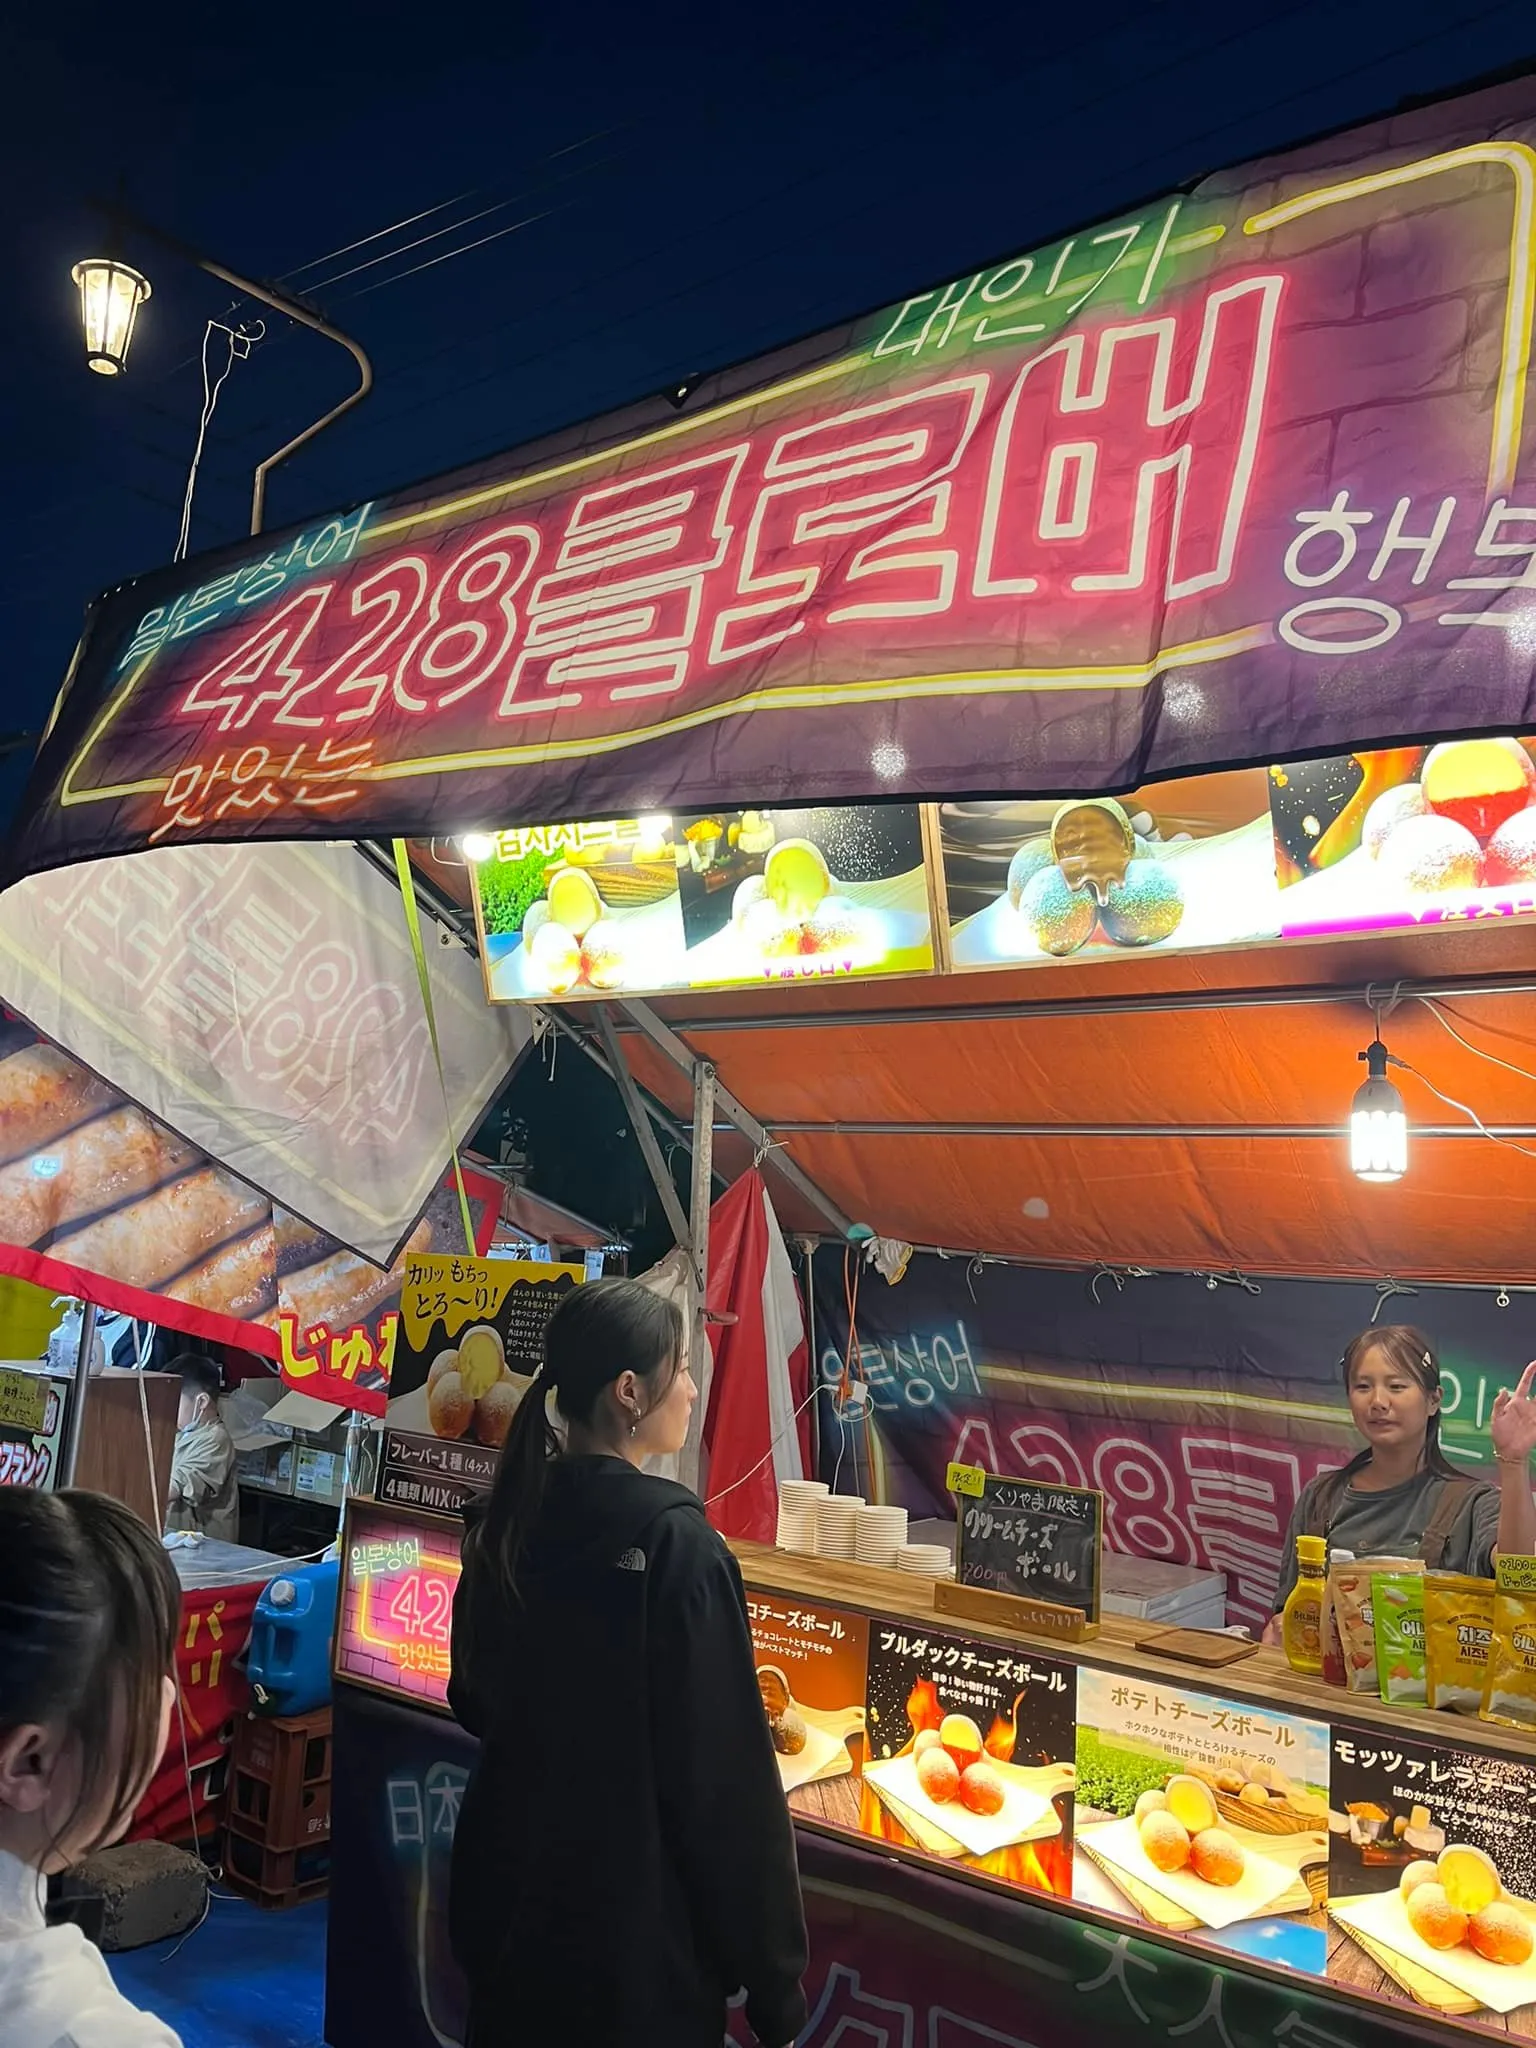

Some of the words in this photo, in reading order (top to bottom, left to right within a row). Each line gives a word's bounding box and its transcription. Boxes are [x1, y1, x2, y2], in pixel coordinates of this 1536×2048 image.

[873, 202, 1182, 357] 대인기
[118, 502, 375, 672] 일본상어
[149, 738, 376, 842] 맛있는
[408, 1264, 443, 1286] カリッ
[451, 1260, 489, 1284] もちっ
[350, 1537, 420, 1577] 일본상어
[880, 1631, 1068, 1693] プルダックチーズボール
[1457, 1625, 1493, 1646] 치즈
[1110, 1687, 1296, 1748] ポテトチーズボール
